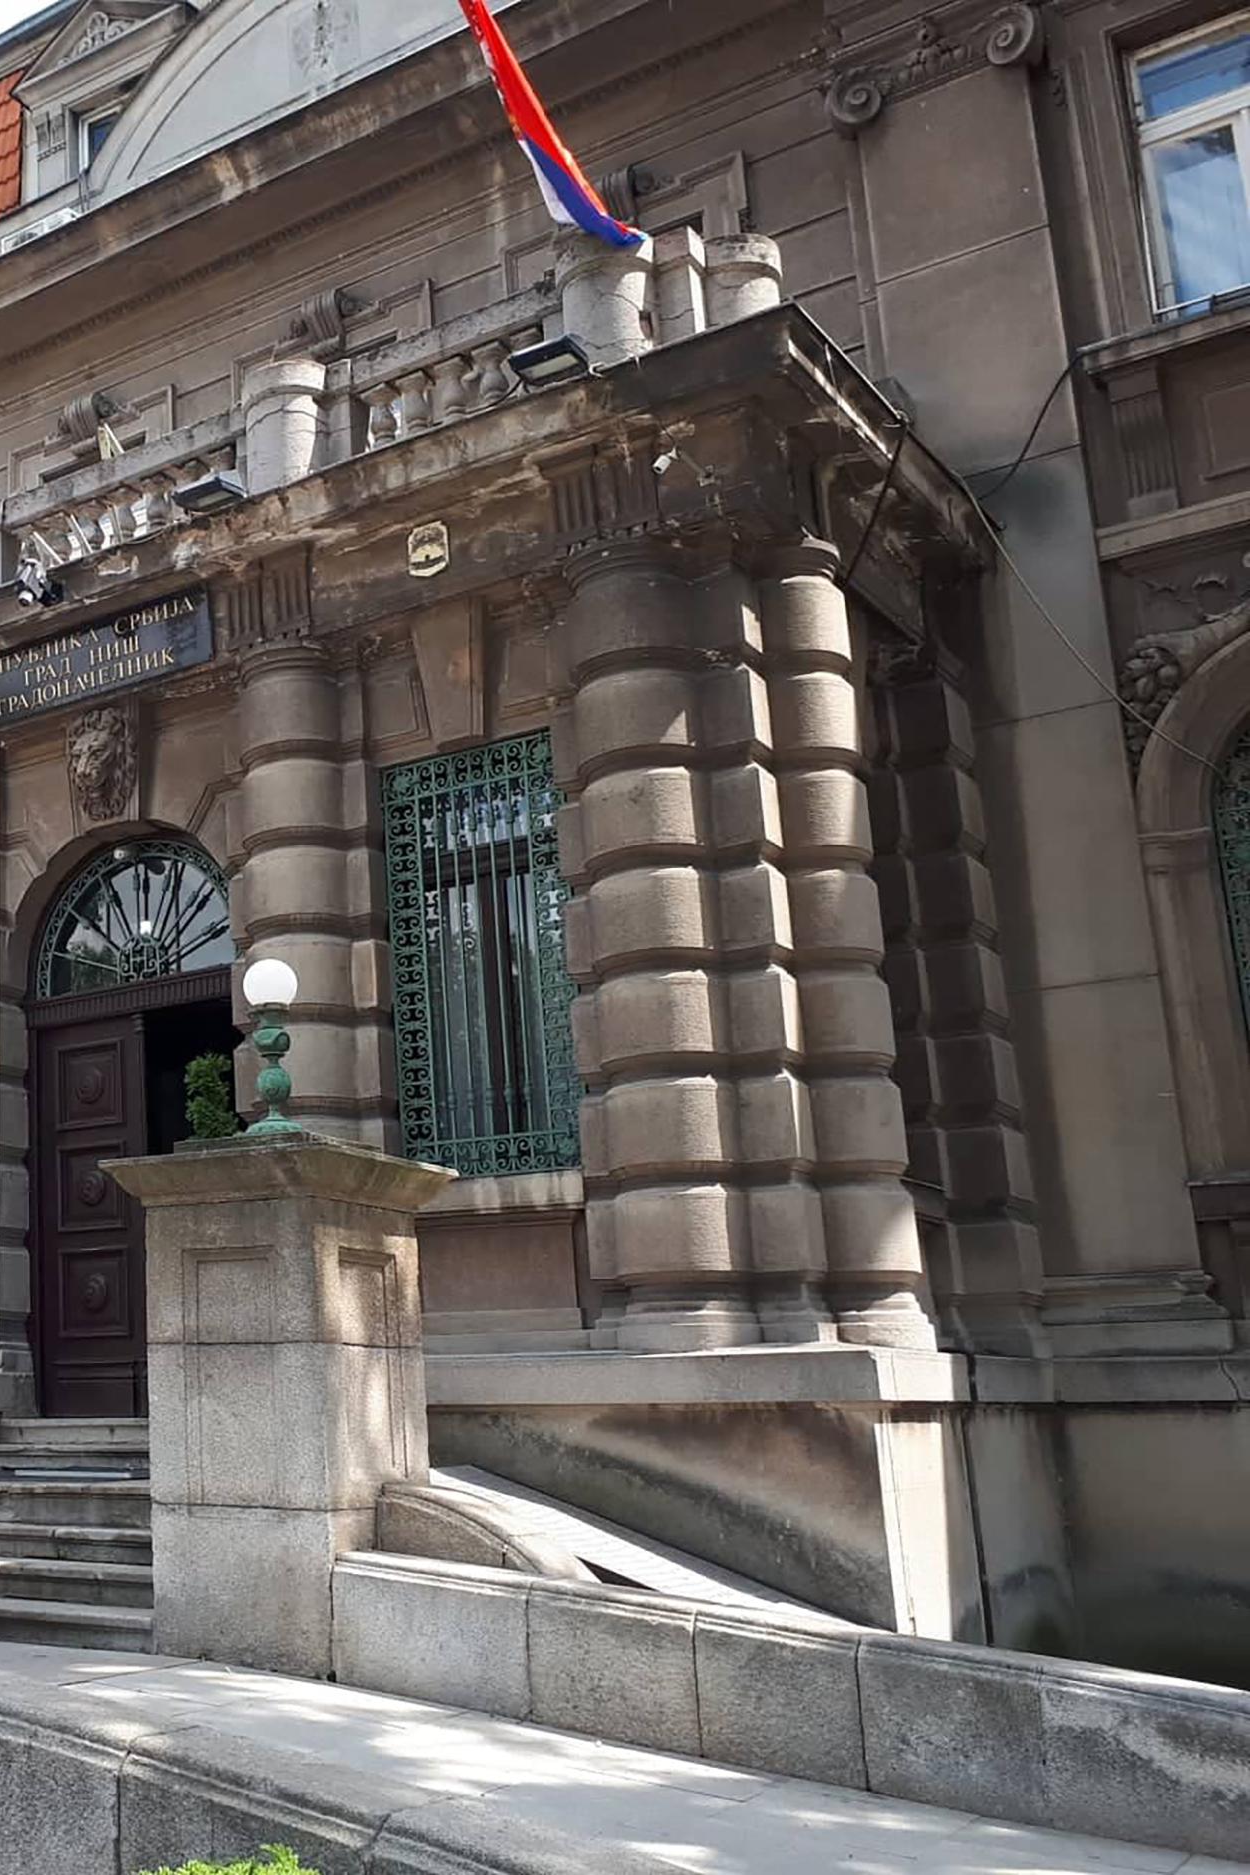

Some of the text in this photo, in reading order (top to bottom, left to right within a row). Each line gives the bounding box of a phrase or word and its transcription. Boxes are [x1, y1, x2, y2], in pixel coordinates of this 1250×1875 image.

[114, 595, 195, 635] СРБИЈА
[23, 635, 140, 687] ГРАД НИШ
